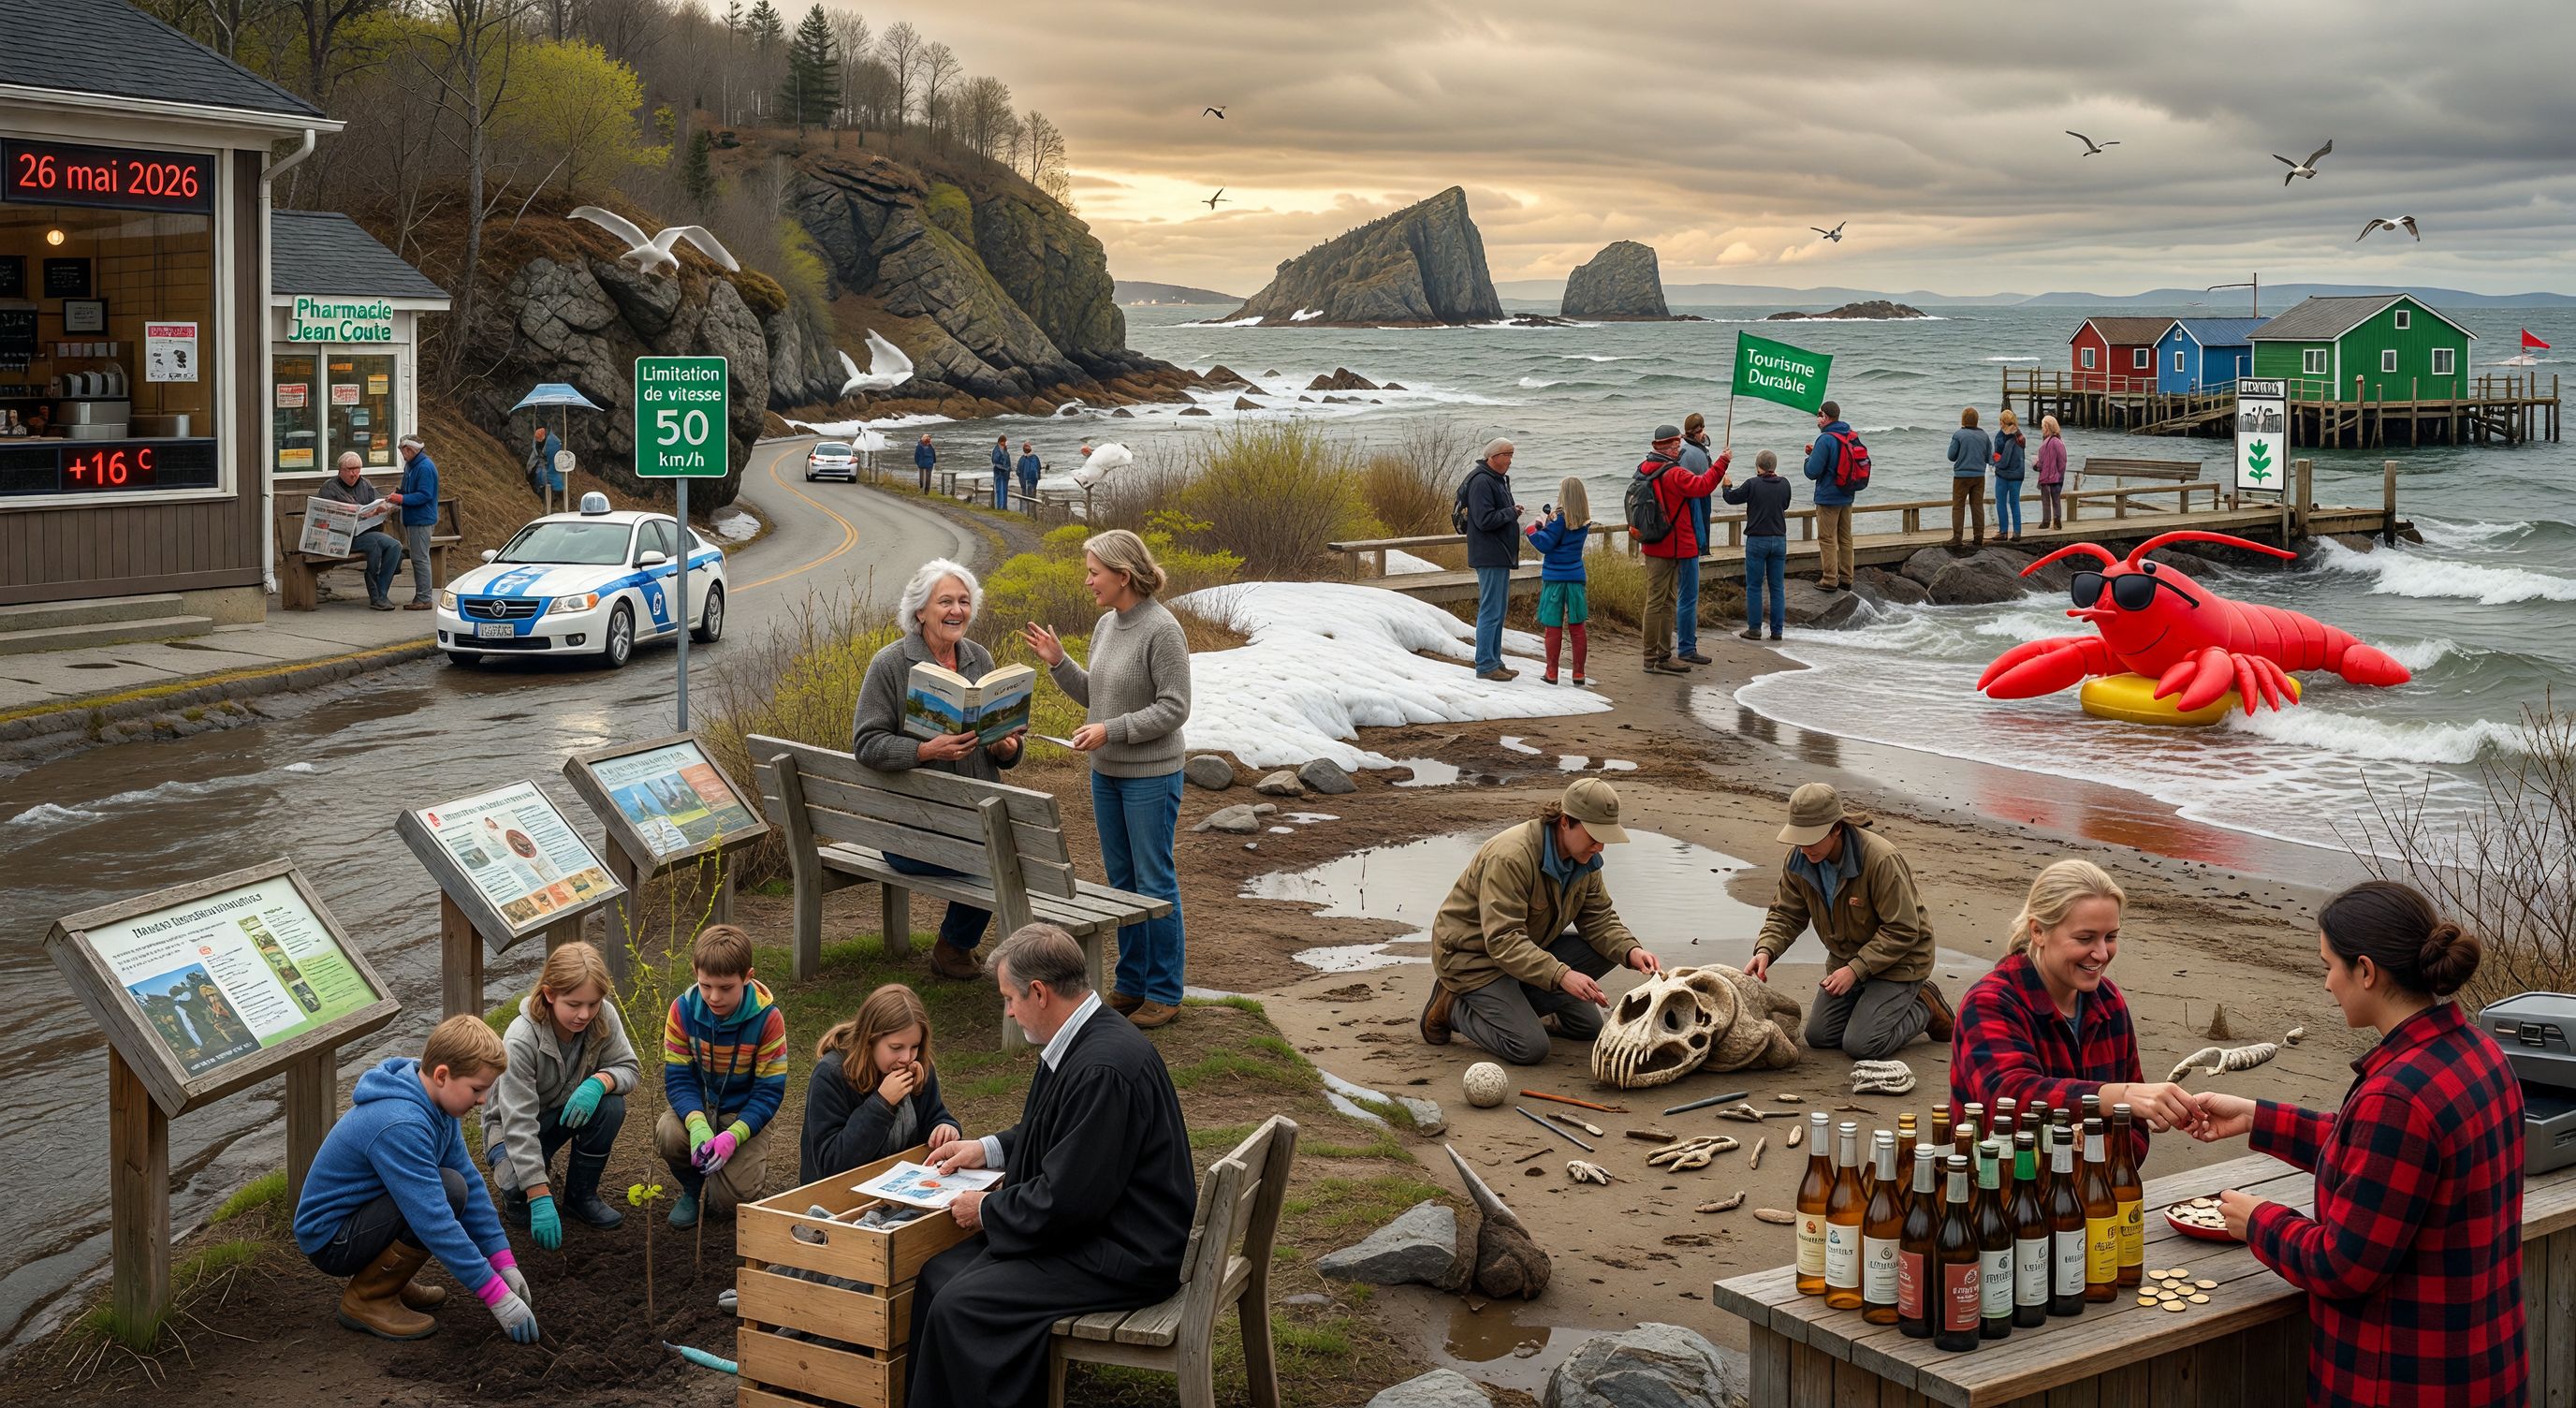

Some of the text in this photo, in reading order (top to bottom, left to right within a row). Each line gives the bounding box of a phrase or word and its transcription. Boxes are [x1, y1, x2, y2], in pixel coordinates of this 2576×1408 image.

[19, 154, 198, 198] 26 mai 2026
[288, 318, 336, 341] Jean
[643, 366, 720, 382] Limitation
[1747, 348, 1815, 378] Tourisme
[644, 385, 722, 403] de vitesse
[1748, 368, 1806, 394] Durable
[657, 409, 710, 446] 50
[69, 451, 127, 485] +16
[659, 451, 705, 467] km/h
